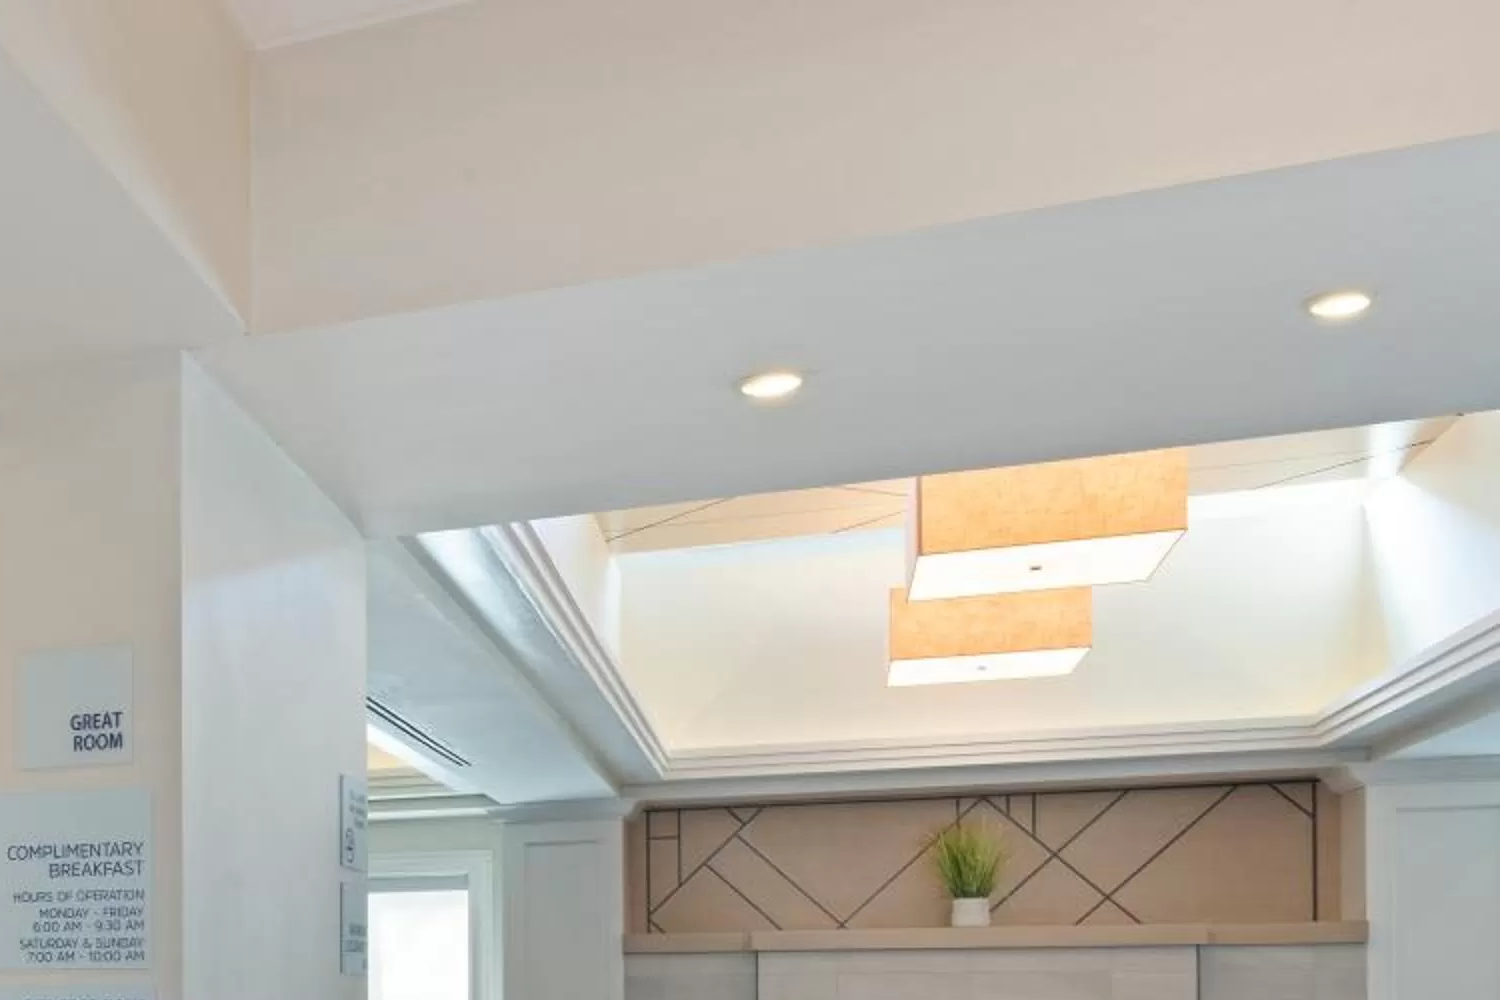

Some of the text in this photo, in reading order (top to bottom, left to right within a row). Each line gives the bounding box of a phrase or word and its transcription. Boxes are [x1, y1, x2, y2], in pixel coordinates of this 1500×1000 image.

[69, 710, 124, 732] GREAT
[73, 731, 124, 752] ROOM
[6, 841, 145, 861] COMPLIMENTARY
[47, 860, 145, 879] BREAKFAST
[12, 888, 145, 904] HOURS OF OPERATION
[39, 907, 89, 919] MONDAY
[103, 906, 144, 918] FRIDAY
[63, 921, 82, 932] AM
[125, 919, 145, 931] AM
[19, 938, 79, 950] SATURDAY
[95, 937, 145, 949] SUNDAY
[57, 951, 75, 962] AM
[125, 950, 145, 961] AM
